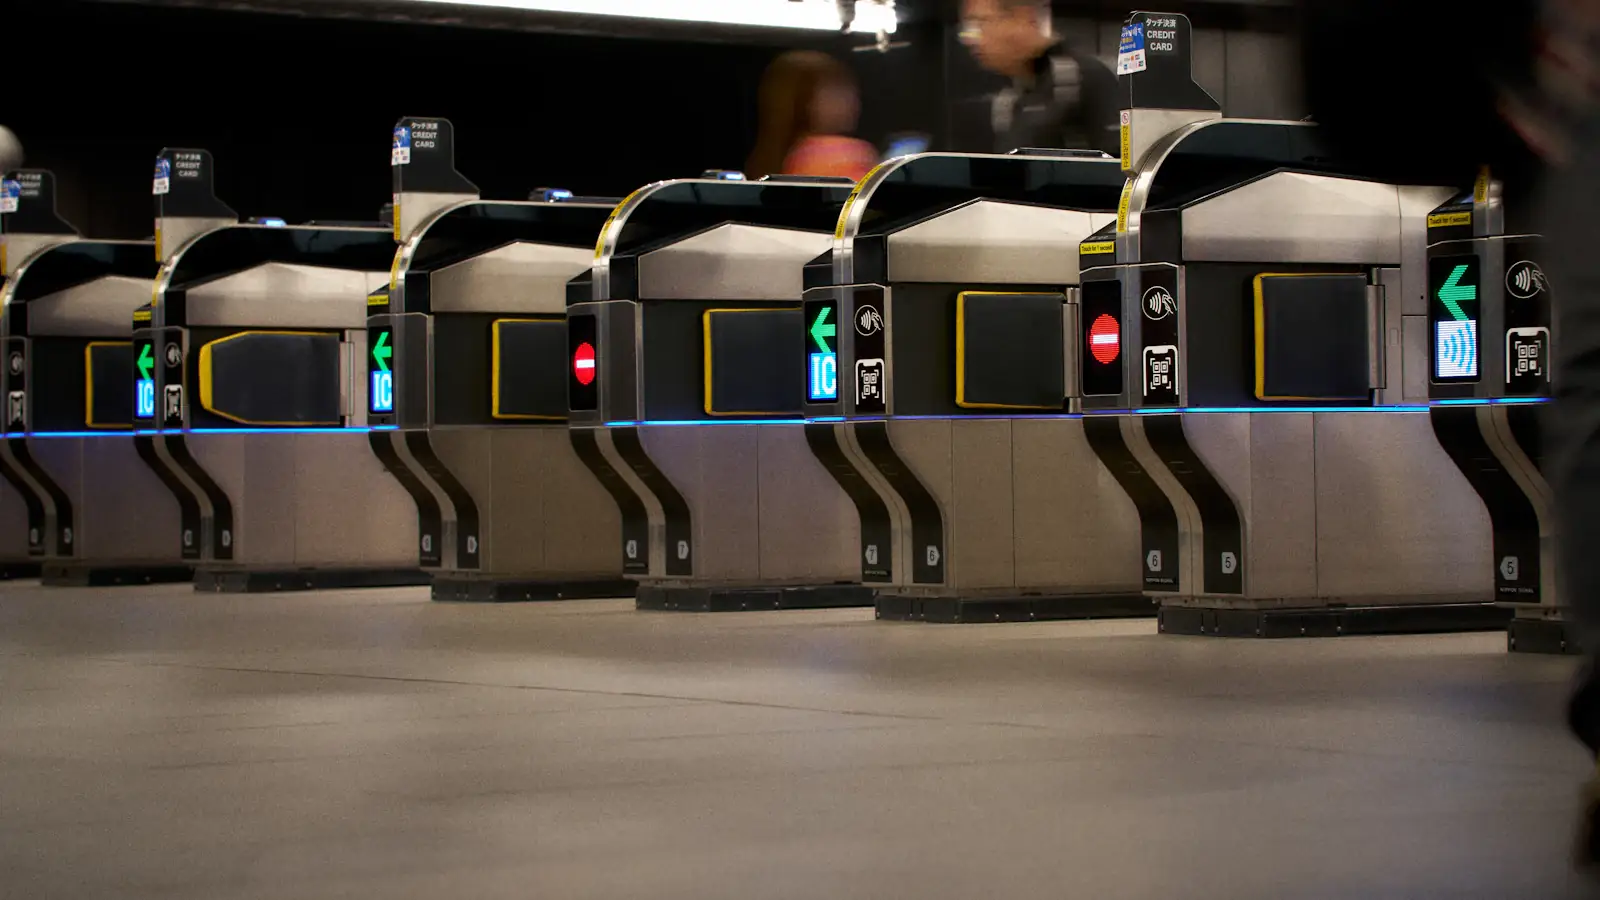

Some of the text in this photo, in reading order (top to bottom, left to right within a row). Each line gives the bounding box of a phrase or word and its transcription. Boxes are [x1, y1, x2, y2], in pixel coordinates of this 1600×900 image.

[1146, 18, 1176, 28] タッチ決済
[1147, 30, 1175, 39] CREDIT
[1150, 42, 1173, 51] CARD
[412, 131, 437, 139] CREDIT
[813, 355, 836, 395] IC
[374, 373, 392, 408] IC
[138, 381, 154, 414] IC
[869, 549, 875, 560] 7
[929, 550, 935, 561] 6
[1152, 554, 1158, 567] 6
[1225, 556, 1231, 569] 5
[1507, 561, 1514, 575] 5
